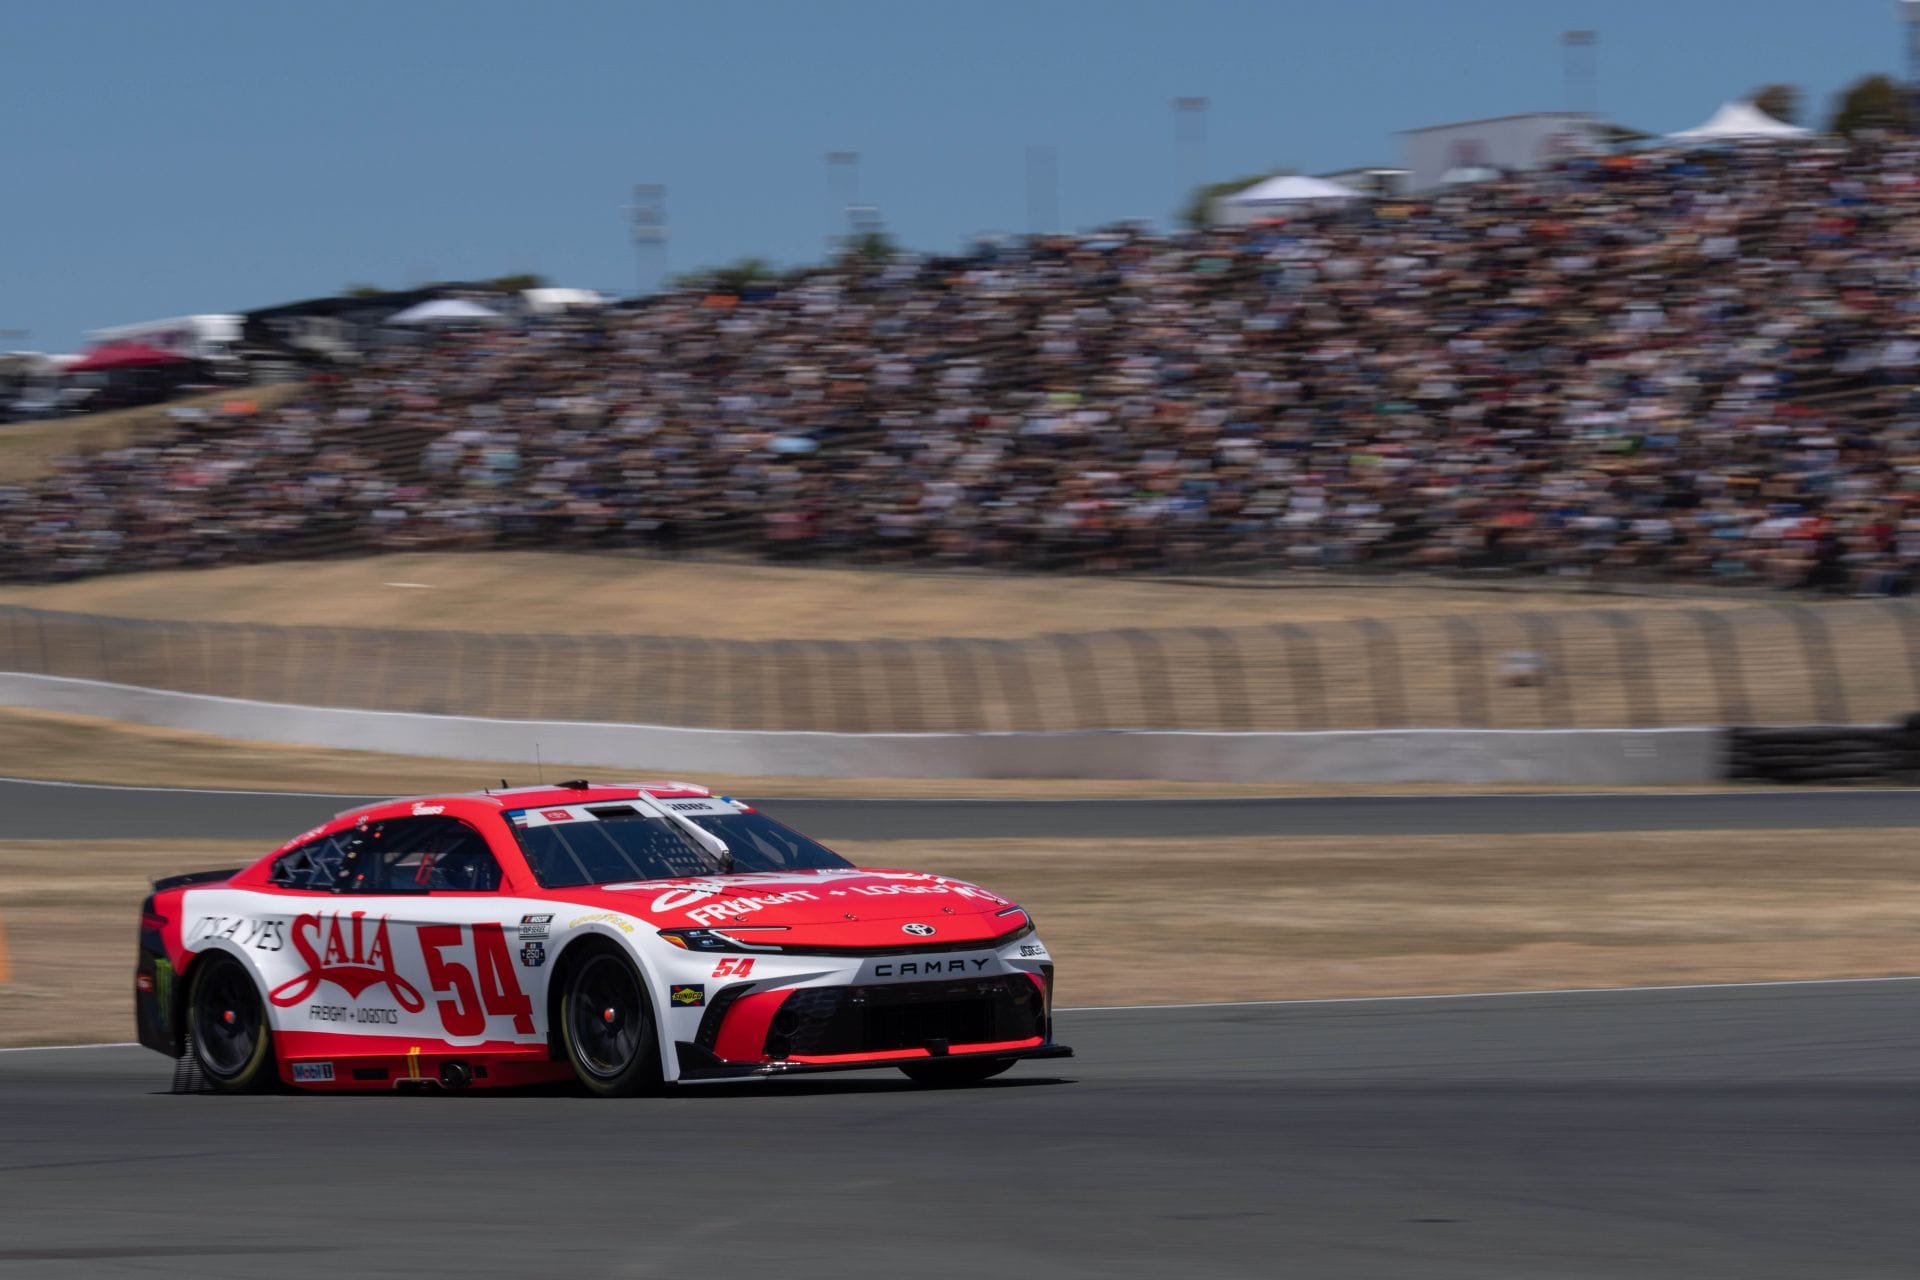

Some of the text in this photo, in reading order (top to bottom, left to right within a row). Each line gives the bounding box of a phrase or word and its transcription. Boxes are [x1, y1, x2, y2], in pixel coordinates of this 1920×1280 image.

[685, 890, 820, 926] FREIGHT
[242, 919, 284, 952] YES
[526, 949, 541, 959] 250
[711, 957, 756, 978] 54
[875, 958, 990, 977] CAMRY
[416, 922, 537, 1036] 54
[673, 992, 703, 1001] SUNOCO
[309, 1005, 347, 1021] FREIGHT
[357, 1007, 398, 1024] LOGISTICS
